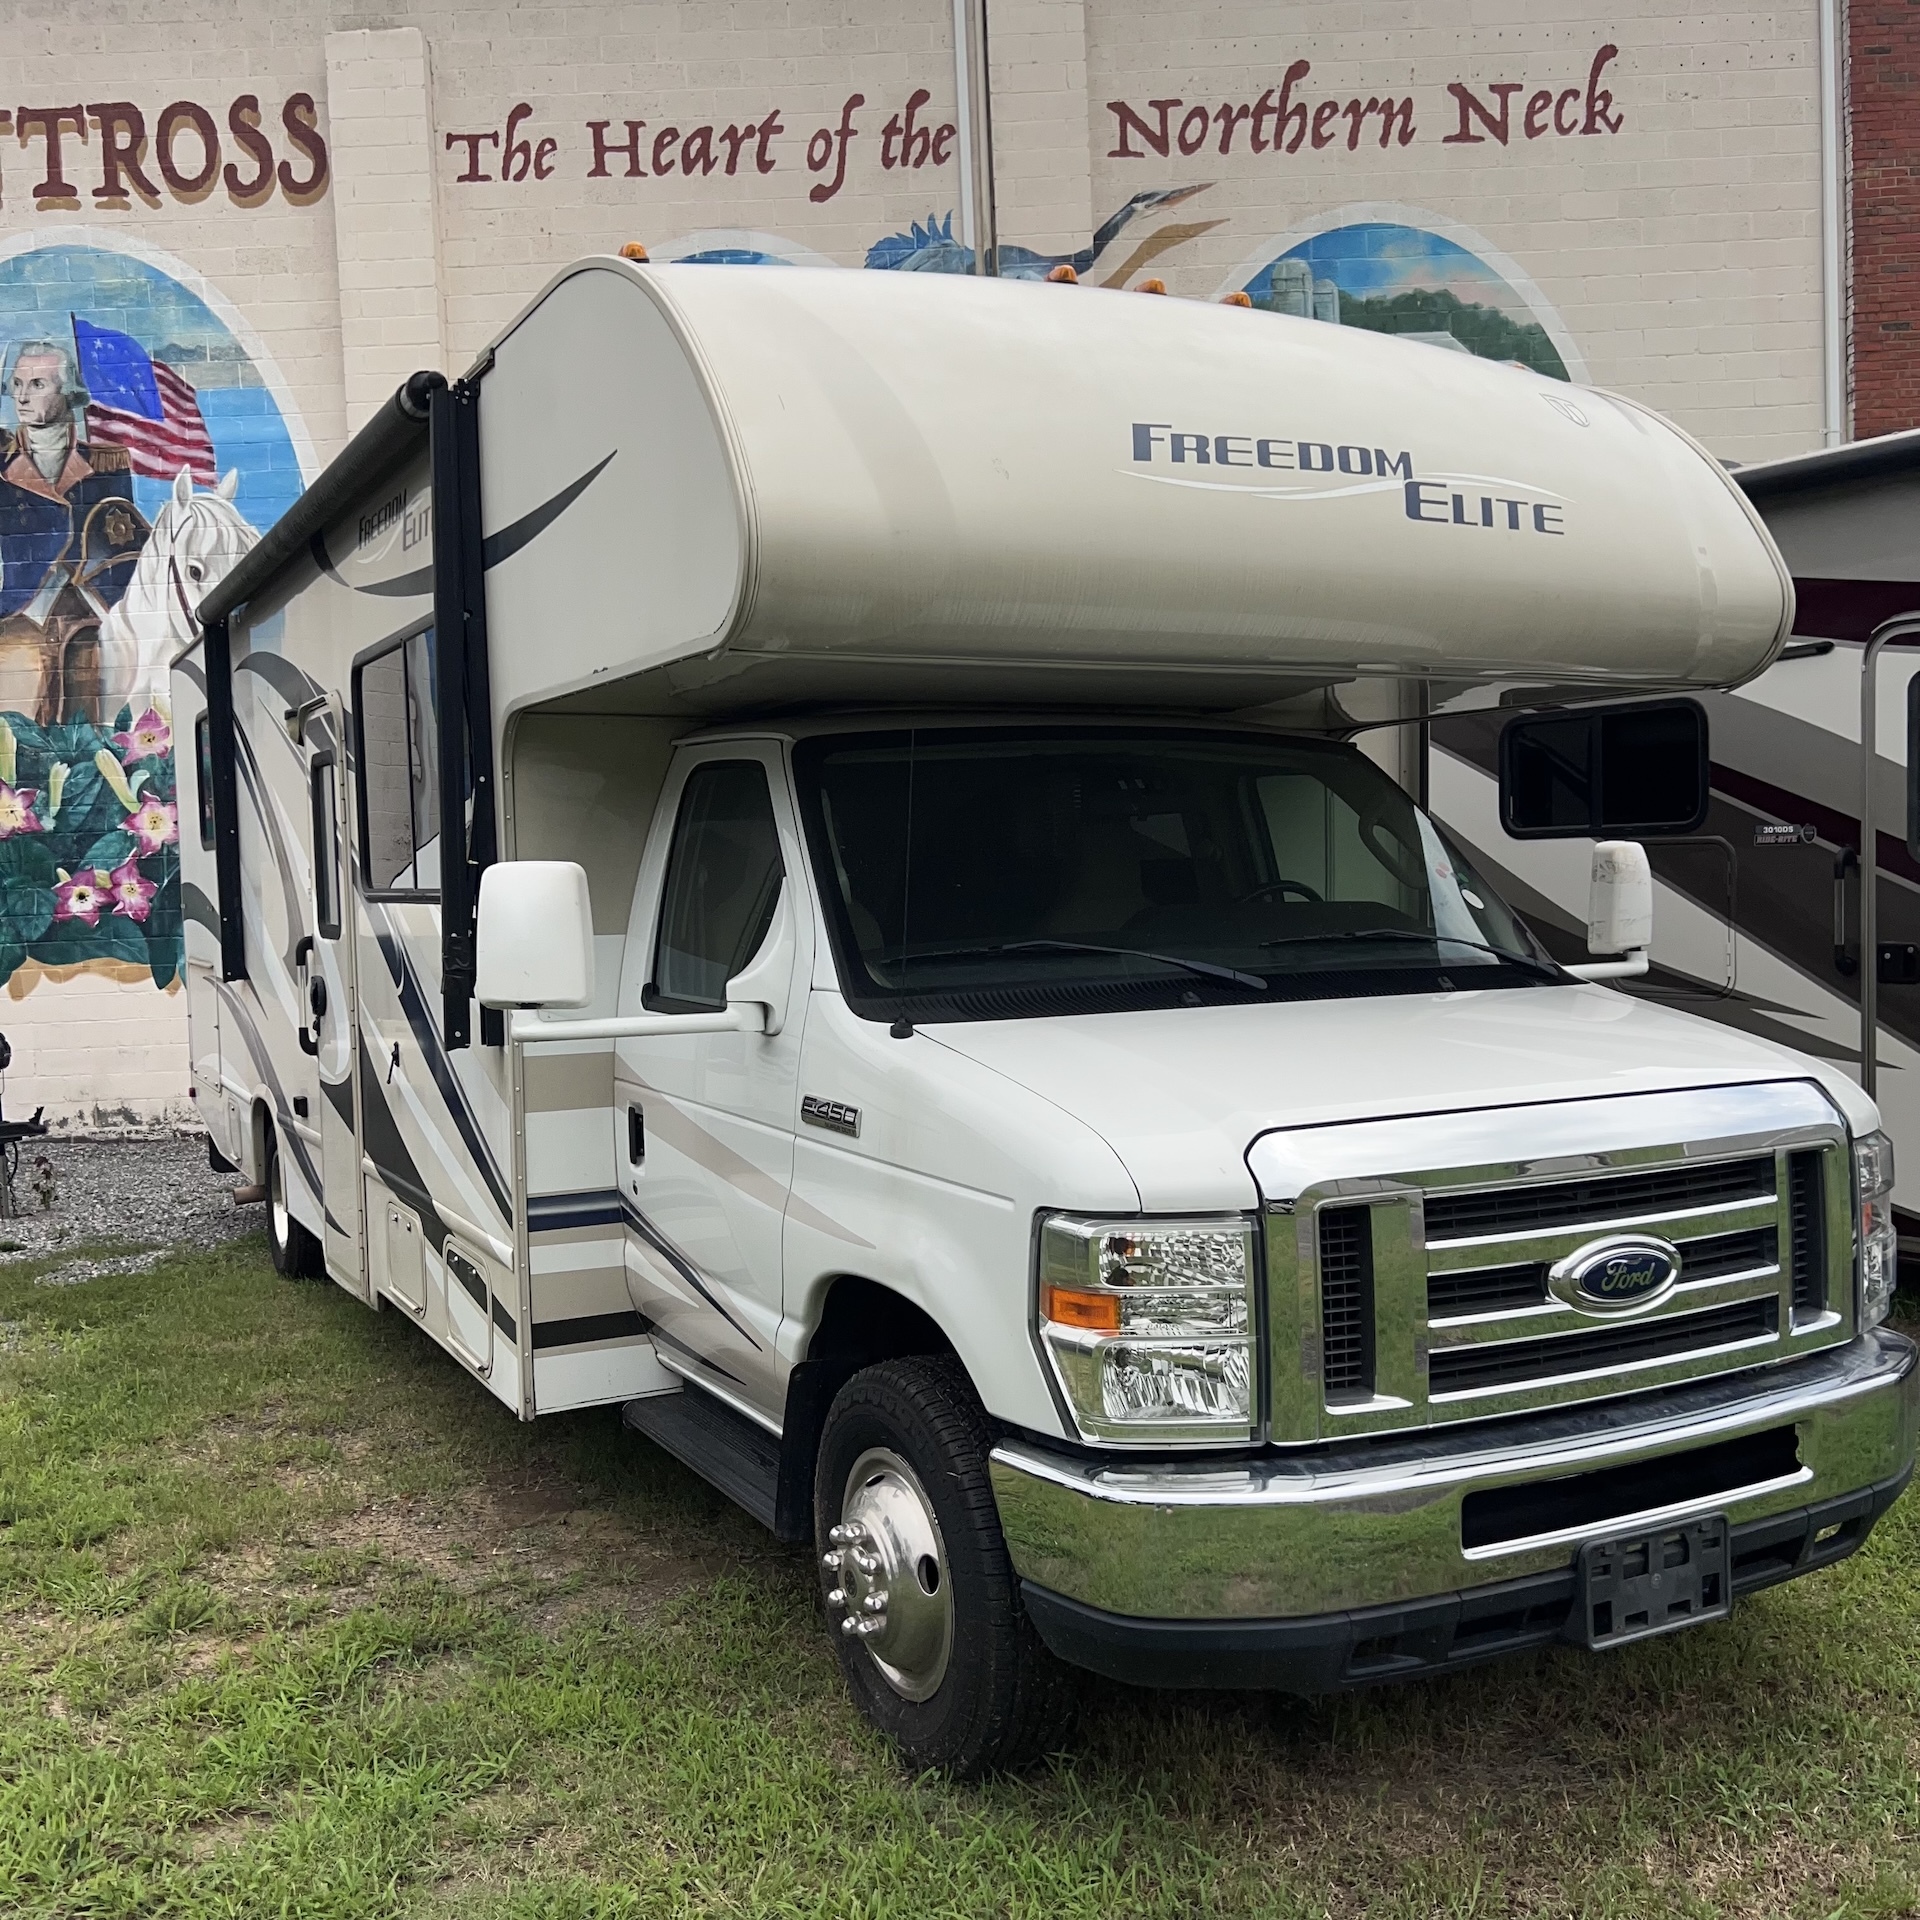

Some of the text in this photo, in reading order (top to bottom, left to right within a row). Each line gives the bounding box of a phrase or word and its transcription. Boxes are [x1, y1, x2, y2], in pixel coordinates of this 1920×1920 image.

[0, 92, 328, 208] TROSS
[445, 44, 1625, 203] The Heart of the Northern Neck
[1132, 423, 1414, 481] FREEDOM
[403, 505, 432, 552] ELIT
[1404, 480, 1565, 536] ELITE
[1601, 1257, 1656, 1292] Ford
